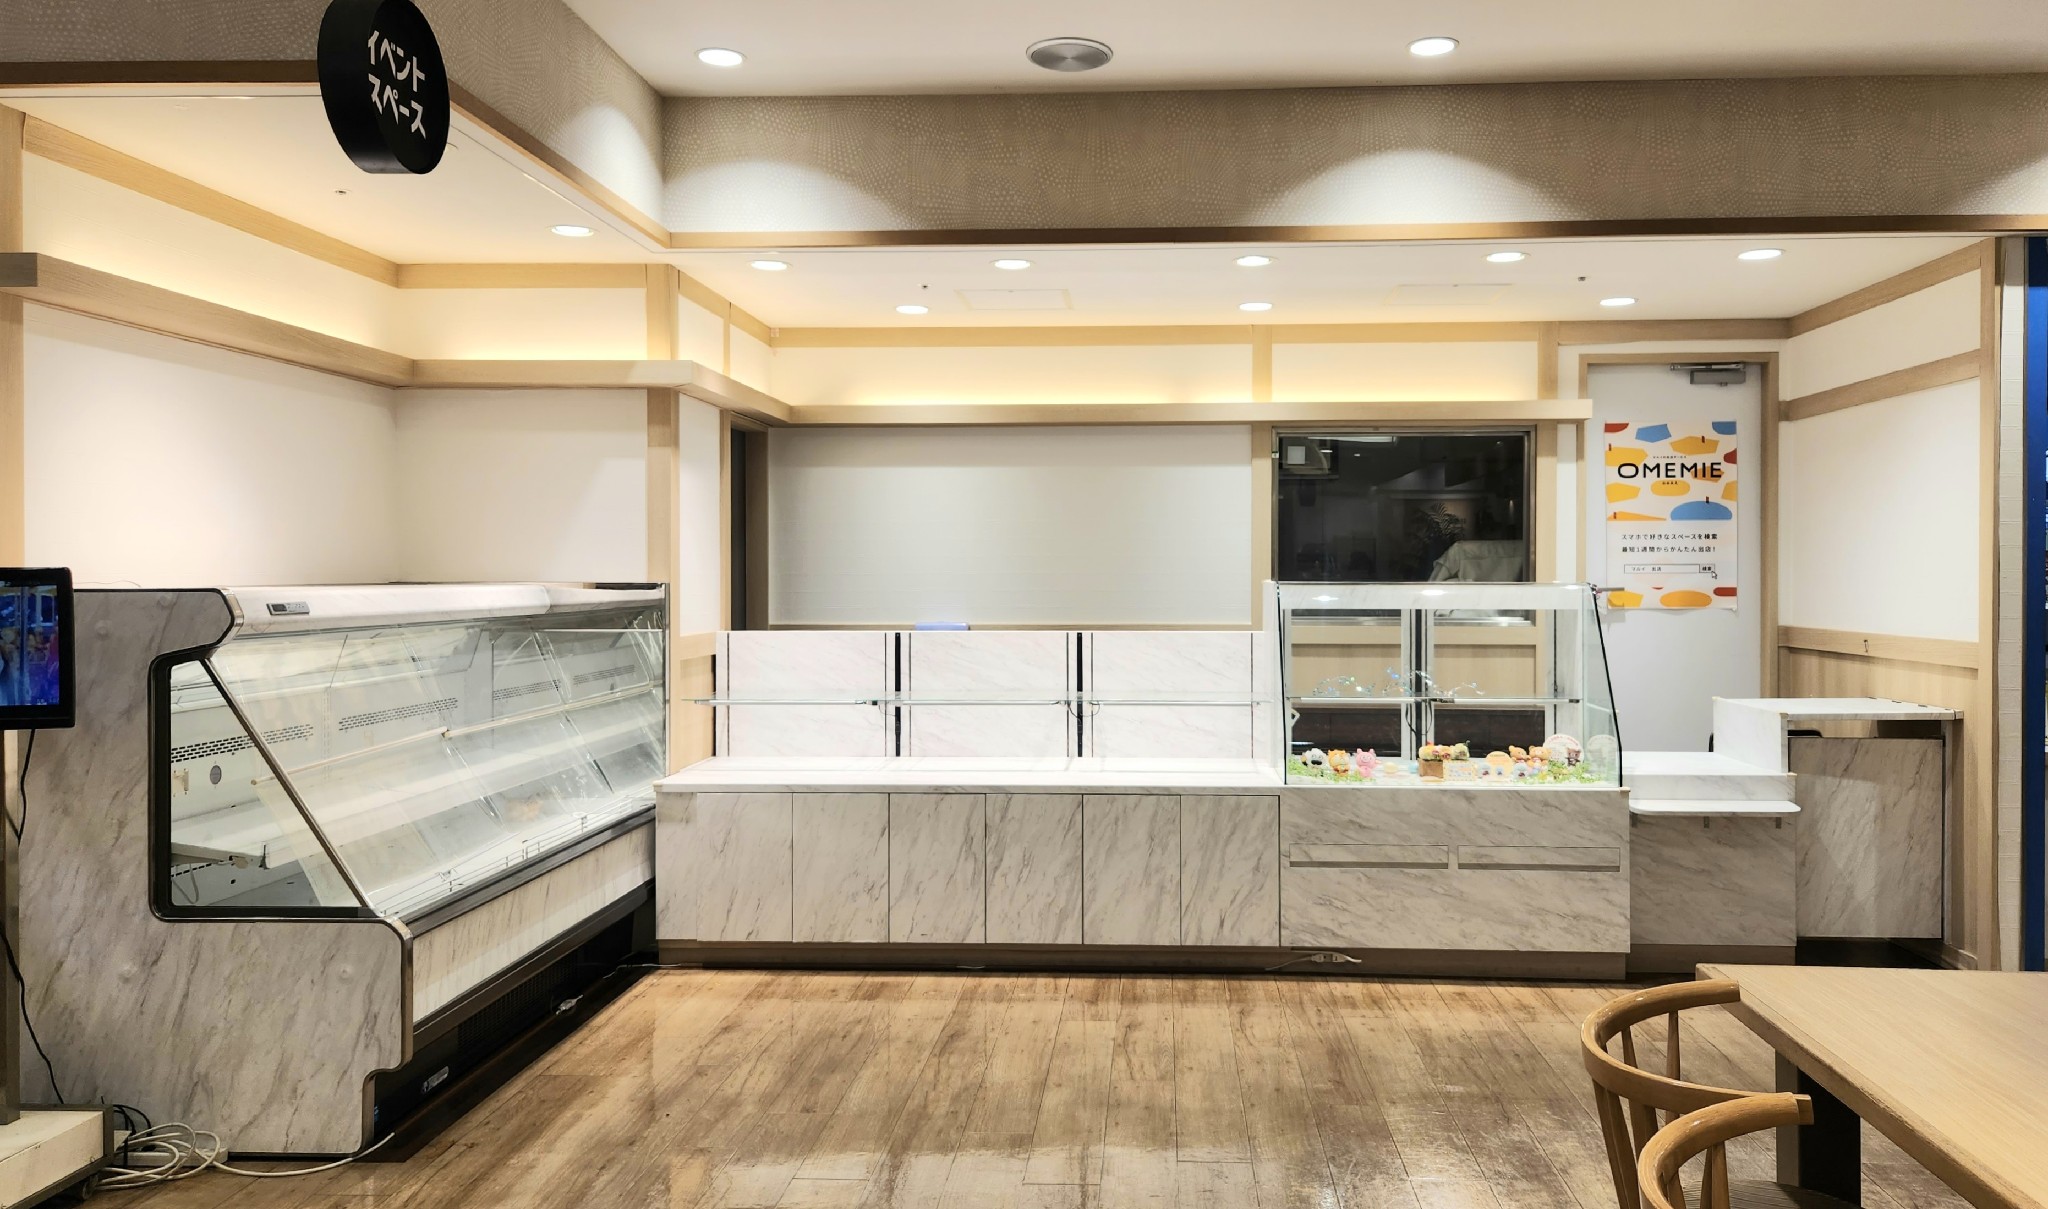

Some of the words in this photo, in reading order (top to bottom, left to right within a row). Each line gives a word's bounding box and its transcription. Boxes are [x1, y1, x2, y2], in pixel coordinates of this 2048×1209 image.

[367, 30, 426, 92] イベント
[368, 73, 426, 139] スペース
[1617, 462, 1722, 478] OMEMIE
[1621, 533, 1719, 541] スマホで好きなスペースを検索
